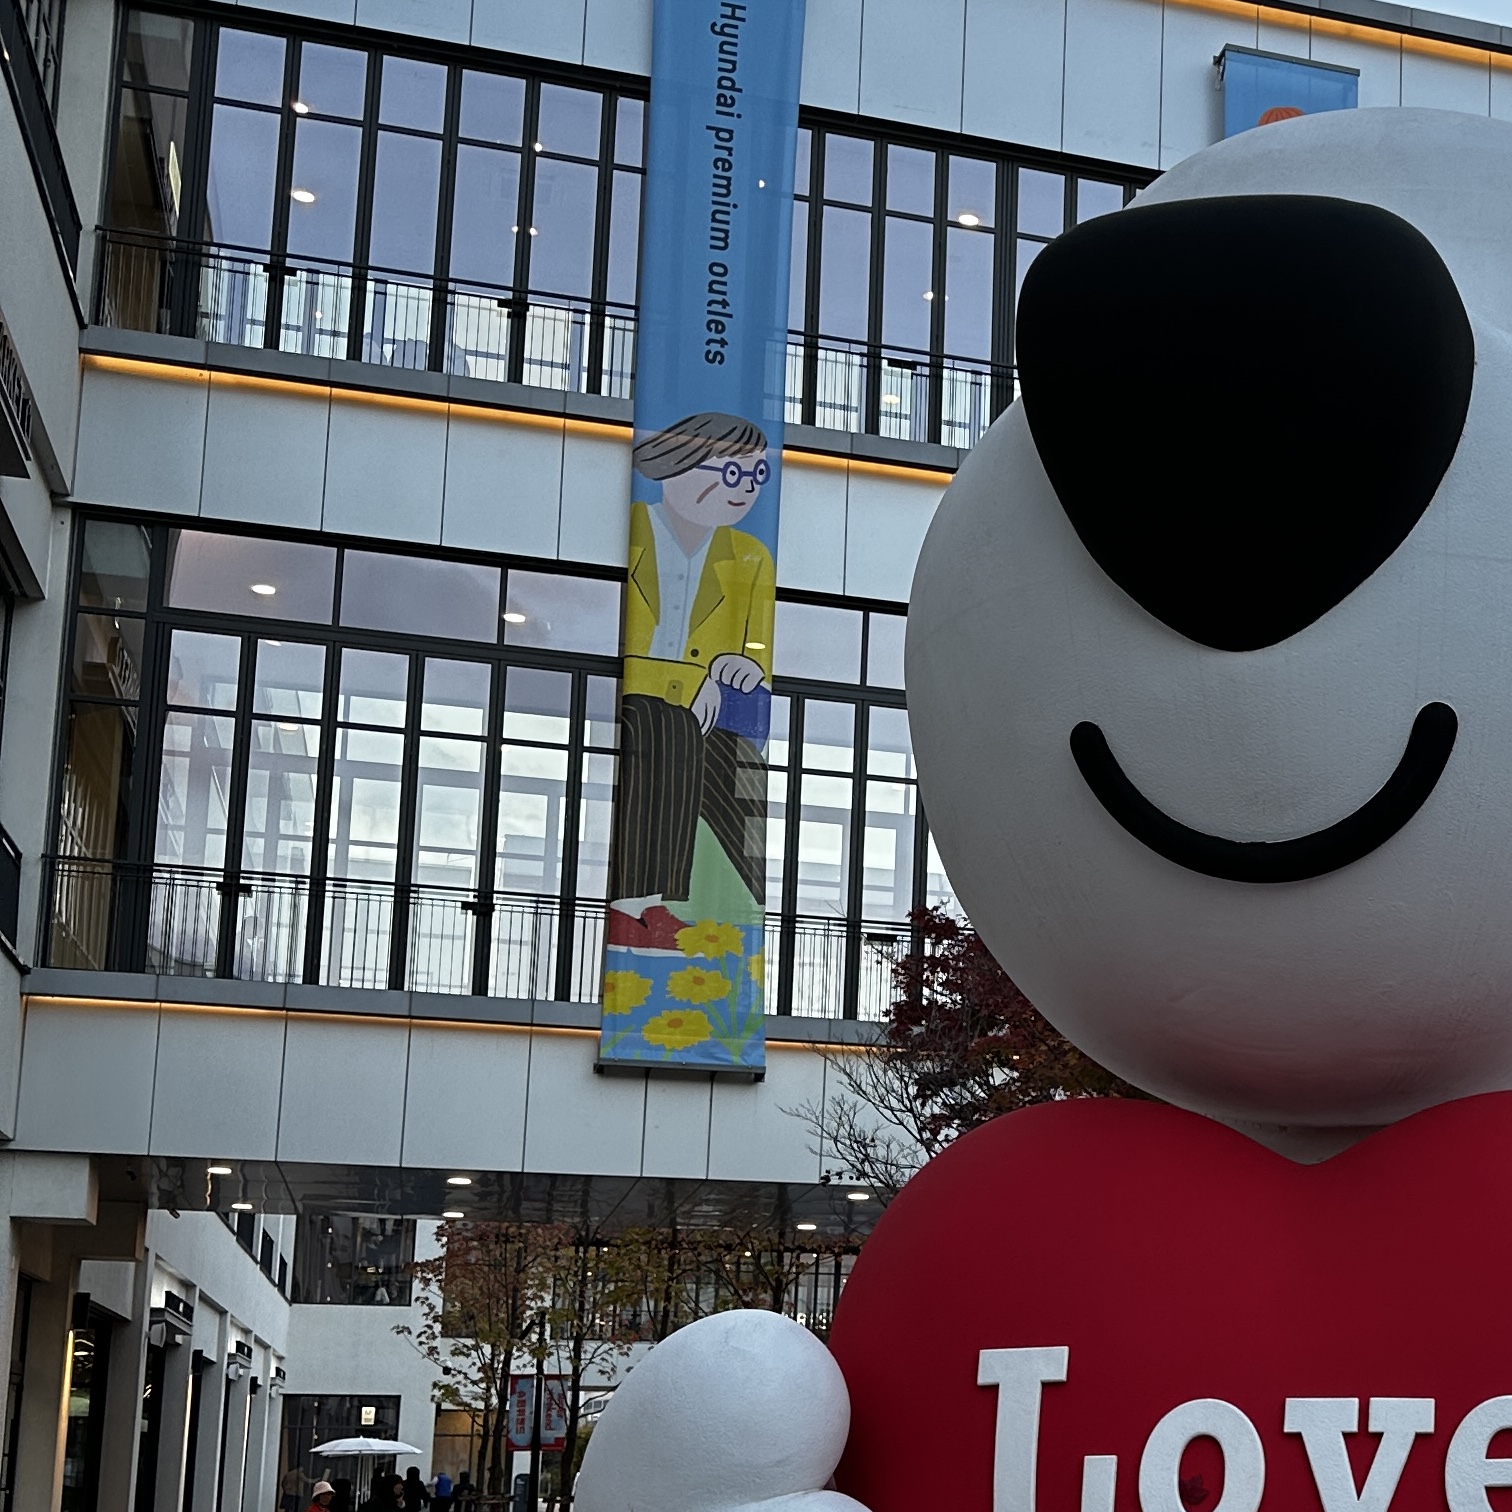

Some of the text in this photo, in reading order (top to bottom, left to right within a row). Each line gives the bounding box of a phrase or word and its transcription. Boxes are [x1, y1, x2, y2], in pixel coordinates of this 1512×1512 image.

[704, 1, 747, 367] Hyundai premium outlets
